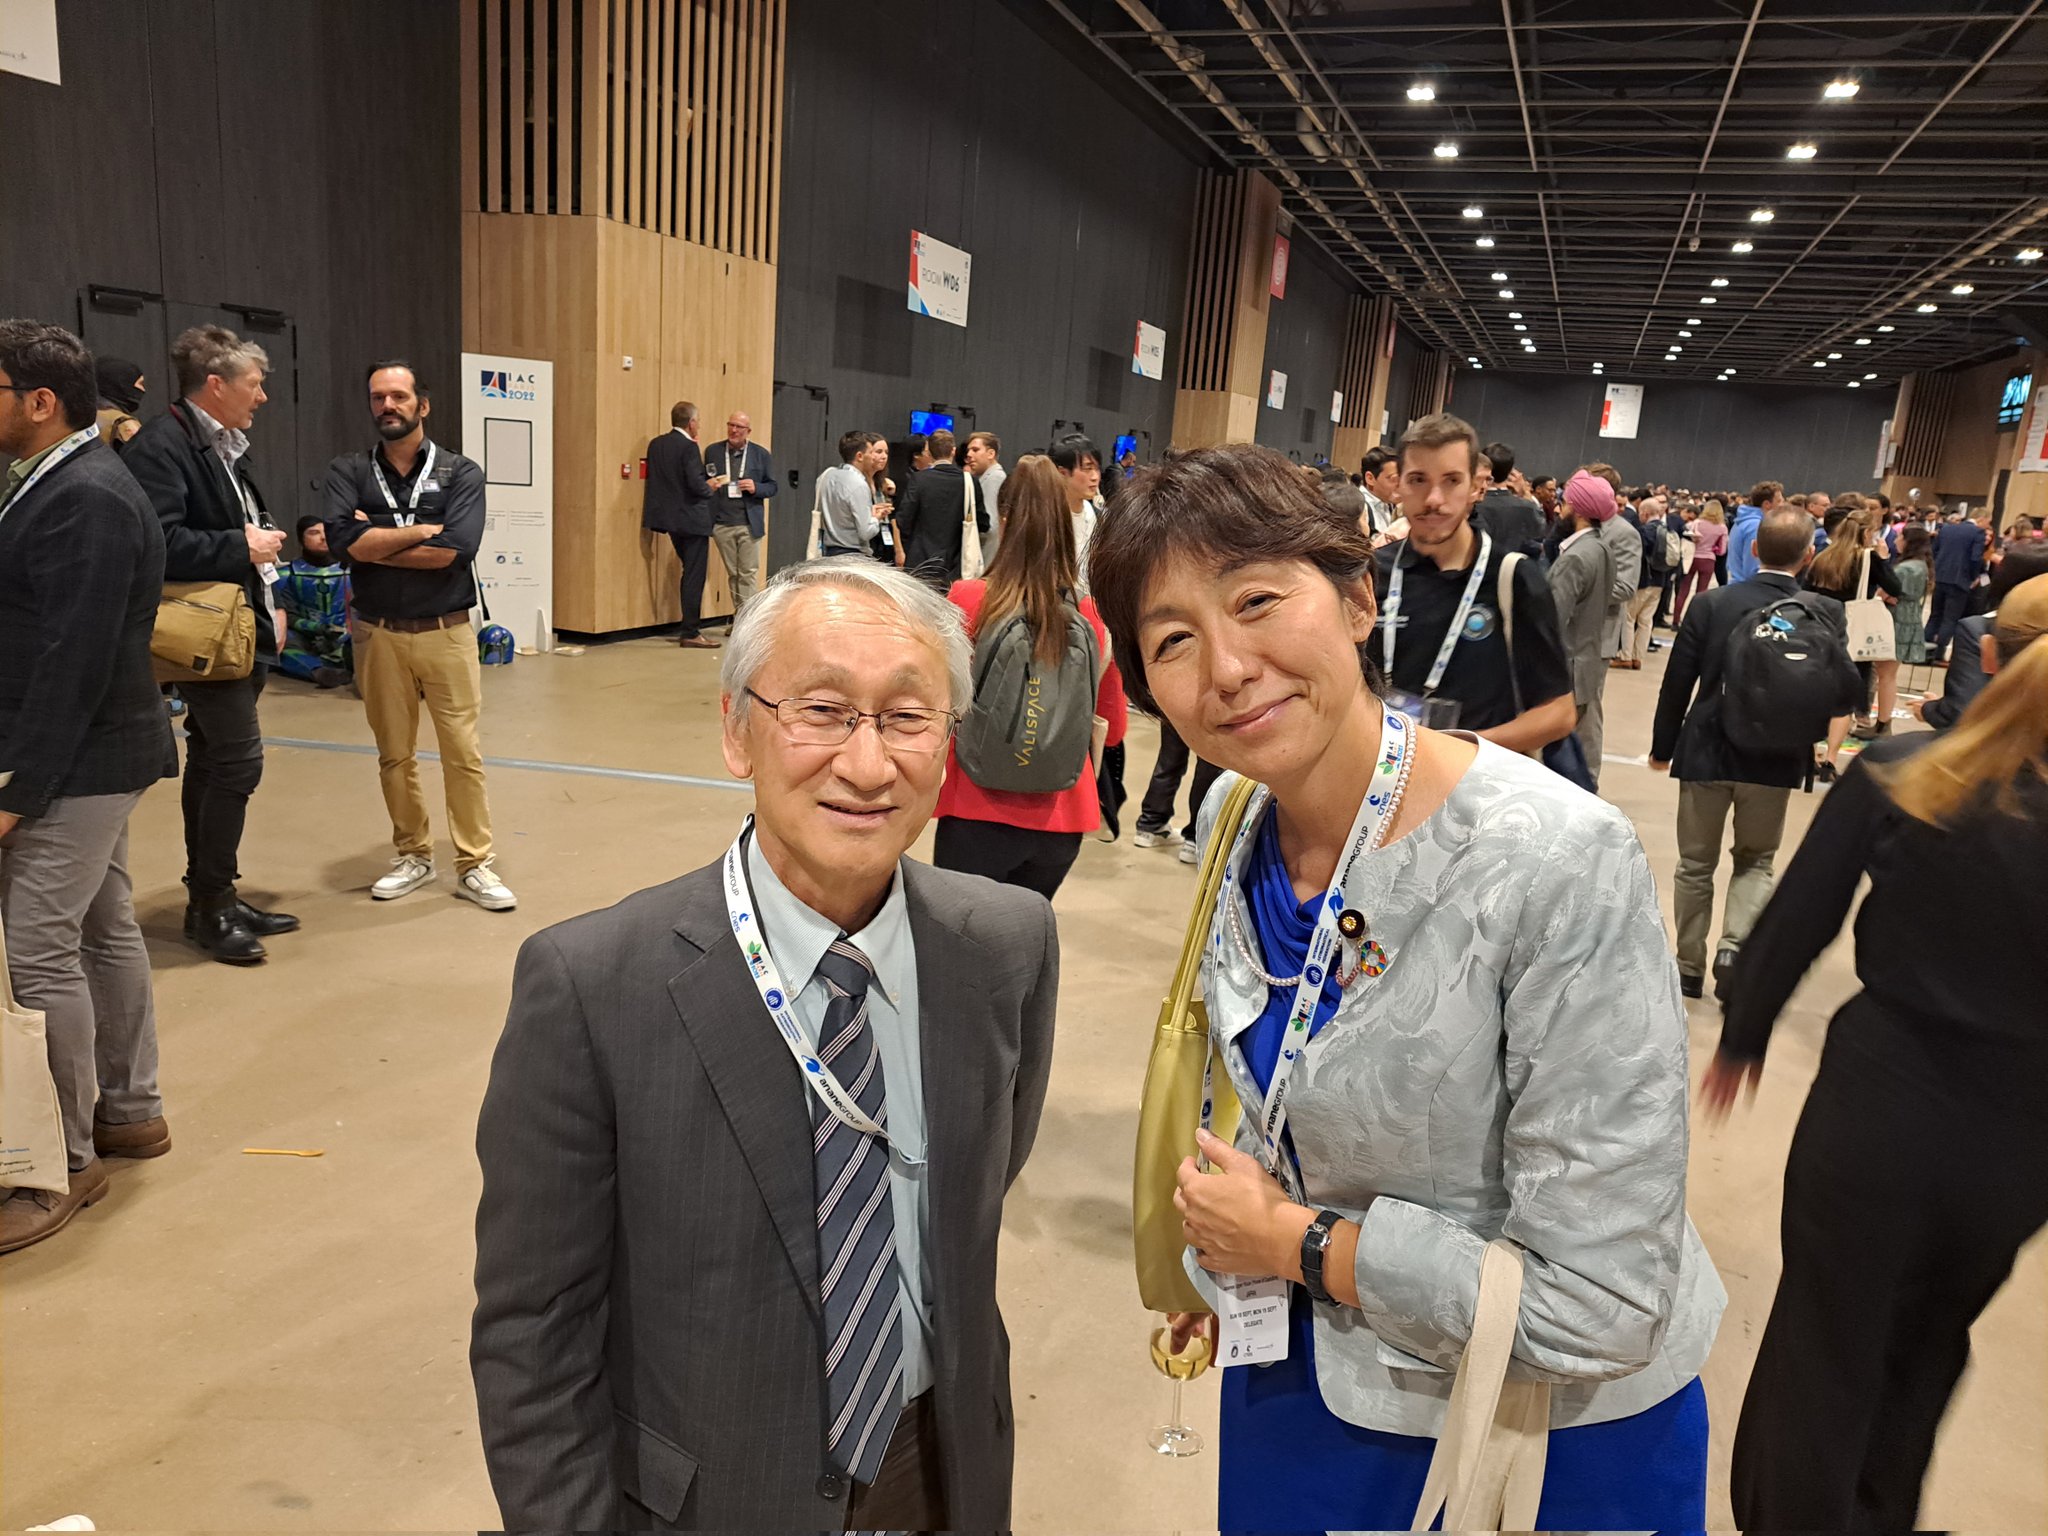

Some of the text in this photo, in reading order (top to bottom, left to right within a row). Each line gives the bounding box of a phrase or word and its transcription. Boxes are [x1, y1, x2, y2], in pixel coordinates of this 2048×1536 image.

[942, 270, 960, 292] W06
[508, 372, 534, 384] IAC
[508, 390, 534, 401] 2022
[1014, 676, 1046, 766] VALISPACE
[1378, 792, 1390, 816] cnes
[730, 910, 740, 932] cnes
[1312, 928, 1324, 959] INTERNATIONAL
[1317, 929, 1330, 961] ASTRONAUTICAL
[758, 958, 768, 975] IAC
[1244, 1320, 1262, 1328] DELEGATE
